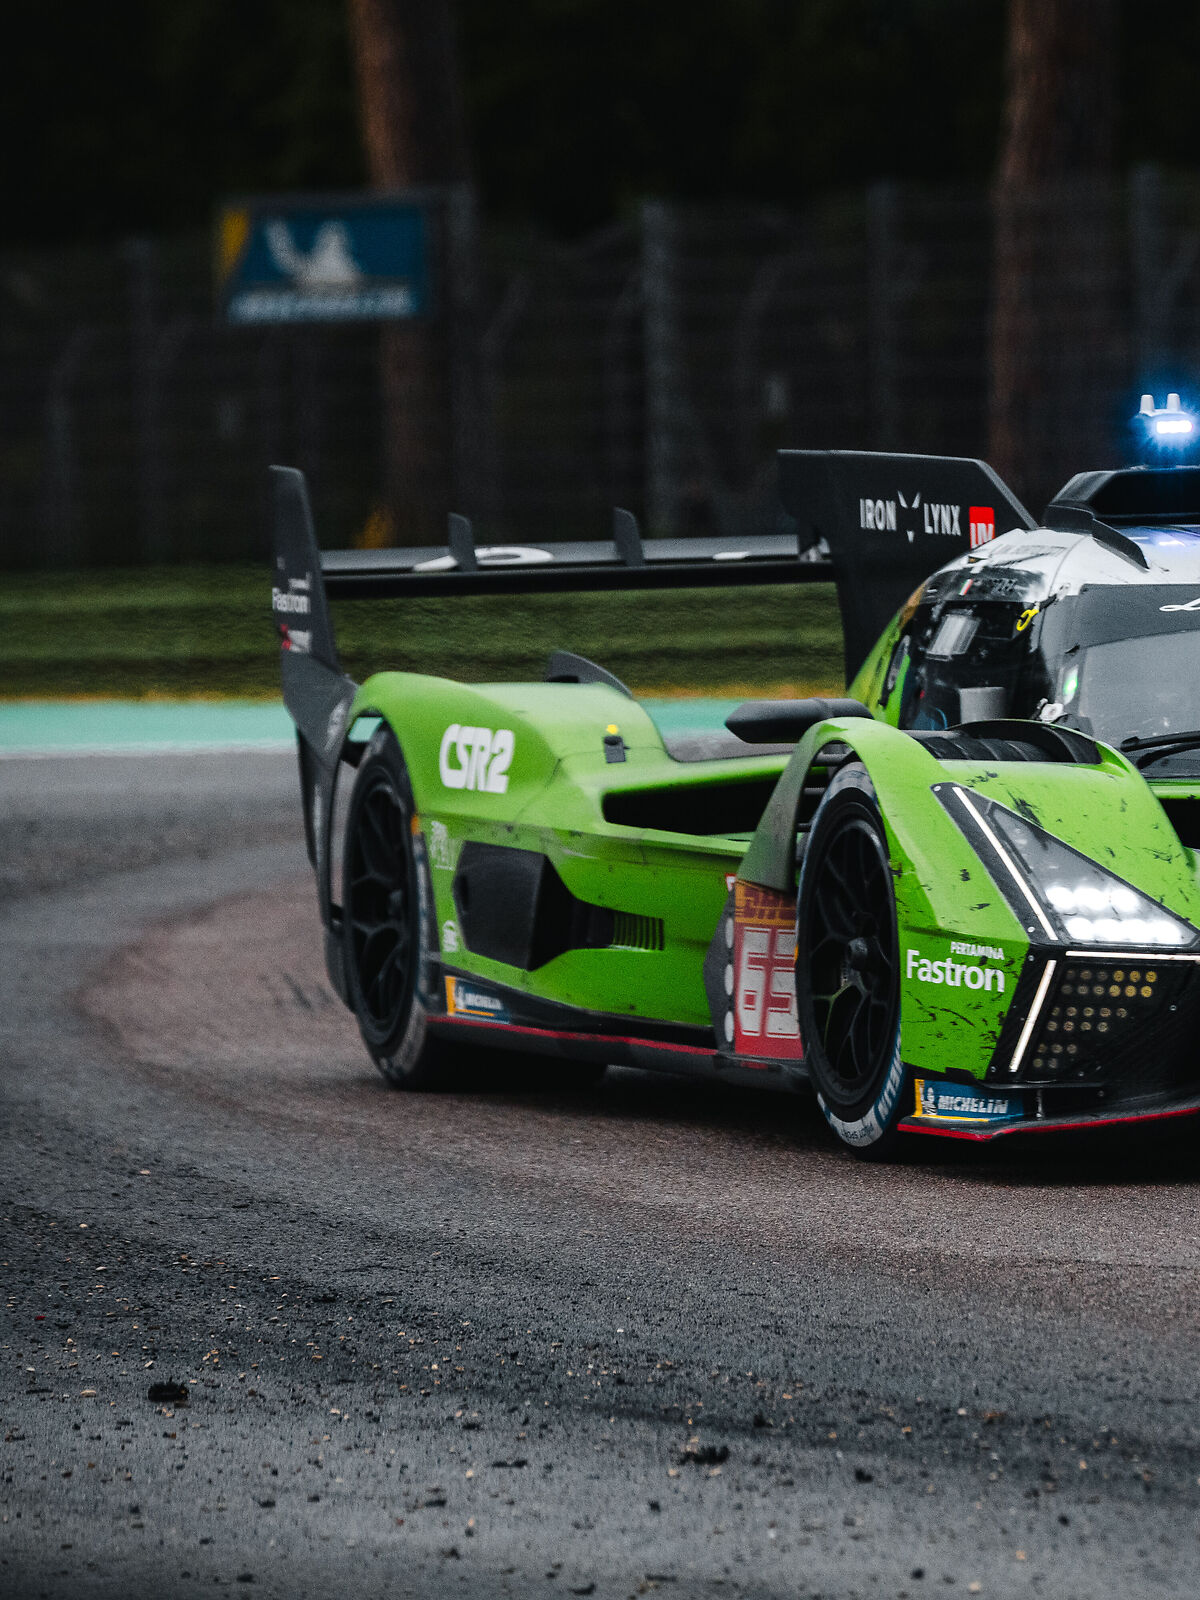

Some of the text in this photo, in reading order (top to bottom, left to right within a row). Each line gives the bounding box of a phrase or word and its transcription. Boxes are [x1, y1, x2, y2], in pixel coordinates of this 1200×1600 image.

[860, 498, 961, 536] IRON LYNX
[439, 723, 515, 794] CSR2
[950, 941, 1005, 961] PERTAMINA
[906, 949, 1005, 993] Fastron
[938, 1095, 1009, 1114] MICHELIN
